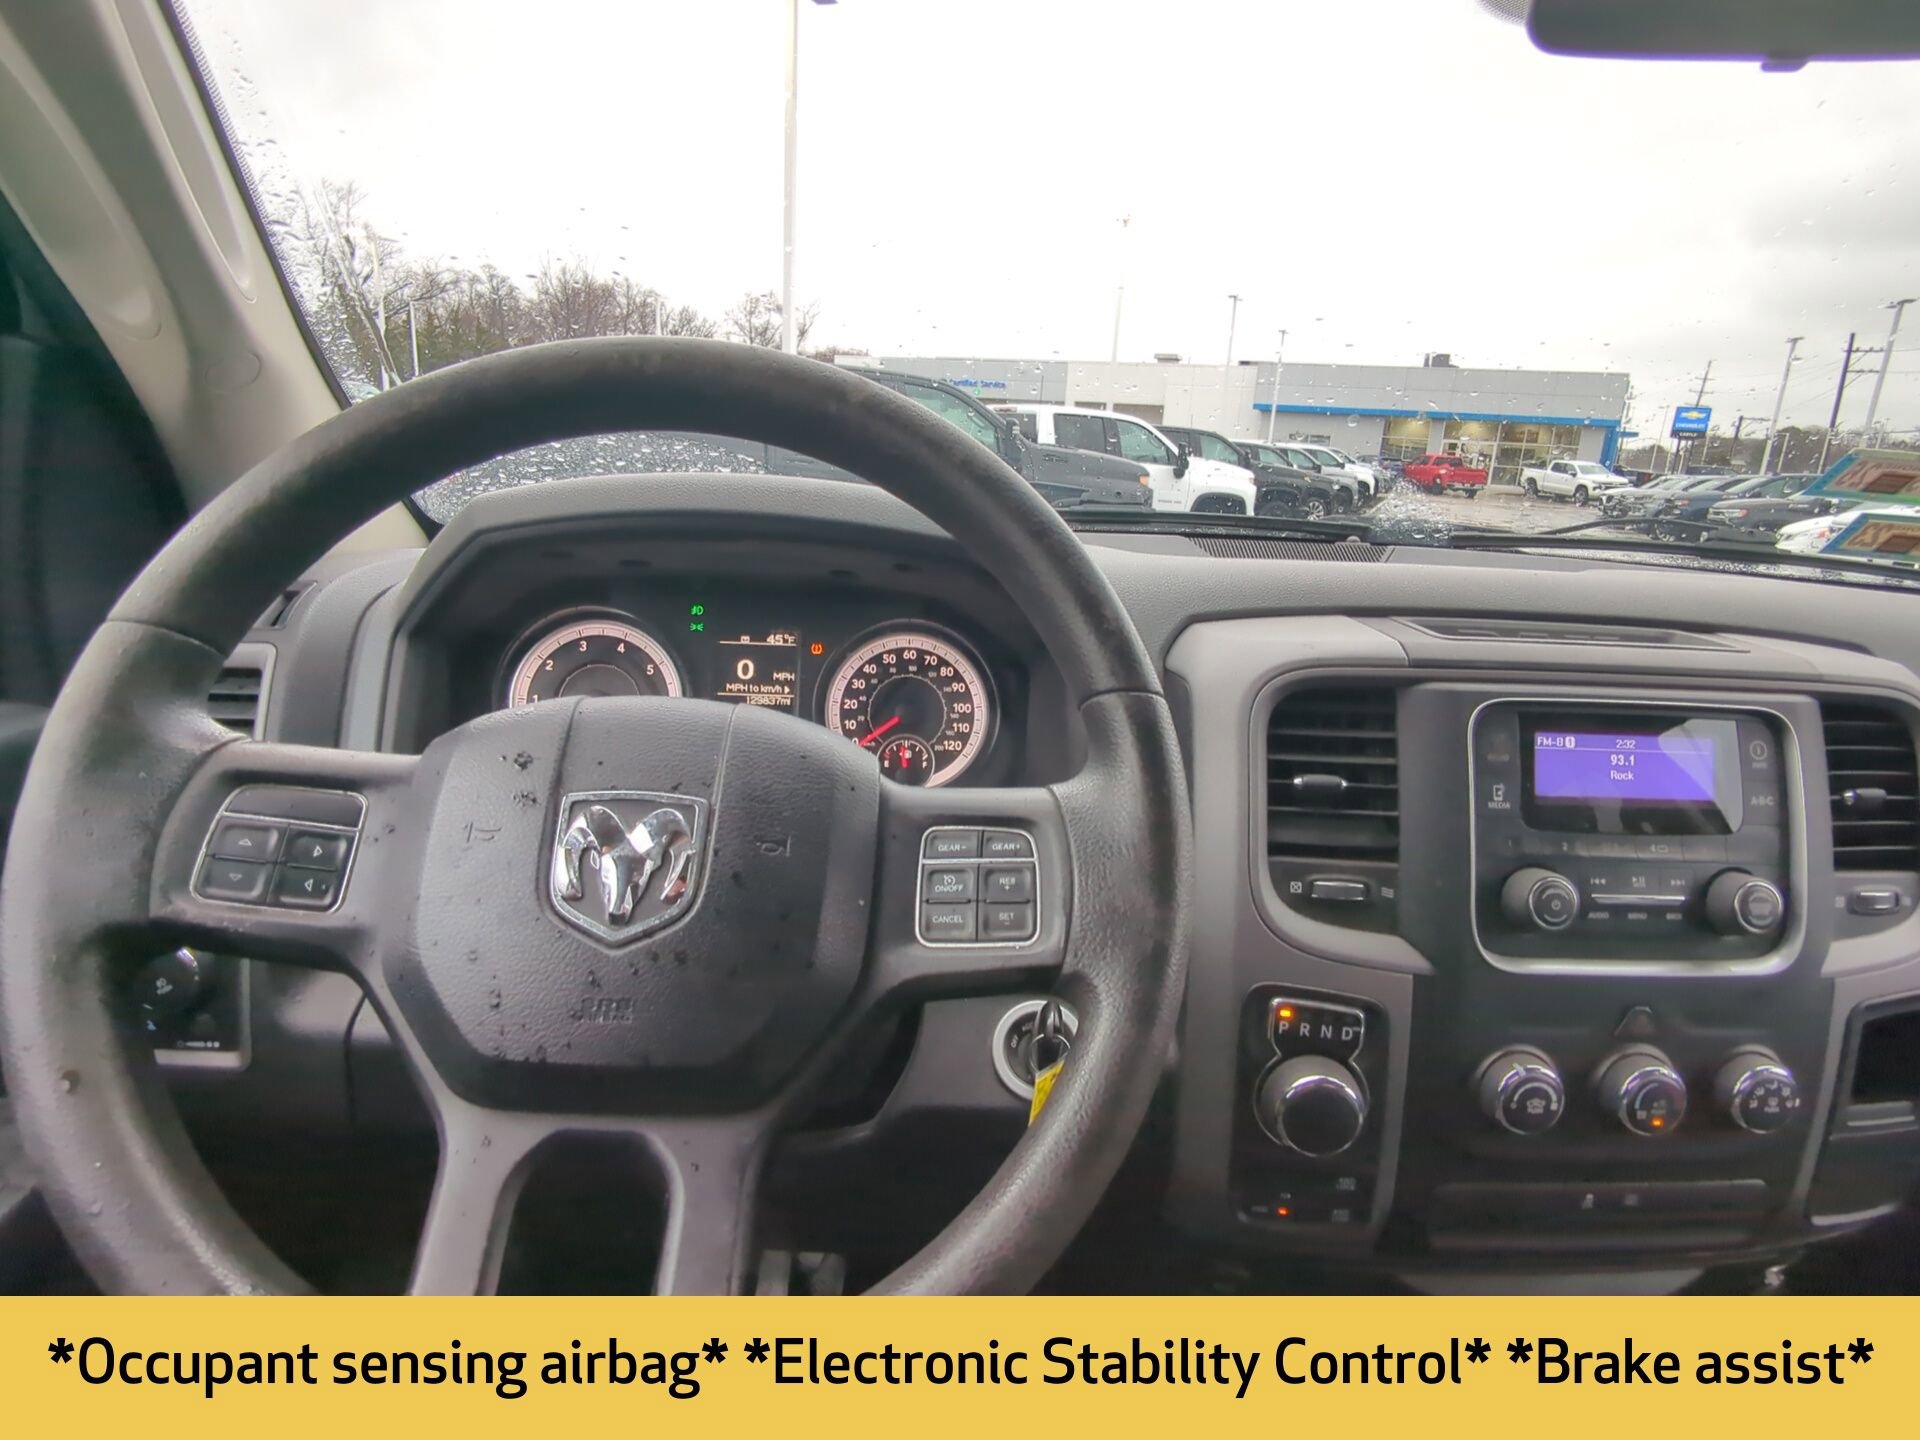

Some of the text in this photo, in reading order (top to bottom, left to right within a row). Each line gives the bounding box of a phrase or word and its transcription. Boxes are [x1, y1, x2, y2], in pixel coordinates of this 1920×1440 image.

[579, 641, 587, 652] 3
[617, 643, 625, 654] 4
[883, 654, 896, 664] 50
[903, 650, 917, 660] 60
[924, 655, 937, 665] 70
[545, 660, 554, 671] 2
[646, 664, 654, 675] 5
[737, 659, 754, 680] 0
[863, 664, 876, 674] 40
[773, 672, 795, 681] MPH
[940, 667, 954, 677] 80
[726, 683, 783, 693] MPH to km/h
[852, 679, 865, 689] 30
[952, 683, 965, 692] 90
[532, 694, 538, 704] 1
[844, 700, 857, 709] 20
[953, 704, 972, 713] 100
[844, 720, 857, 729] 10
[953, 724, 970, 733] 110
[943, 741, 962, 750] 120
[1610, 754, 1635, 766] 93.1
[1610, 770, 1634, 780] Rock
[932, 915, 963, 924] CANCEL
[1278, 1021, 1353, 1040] P R N D
